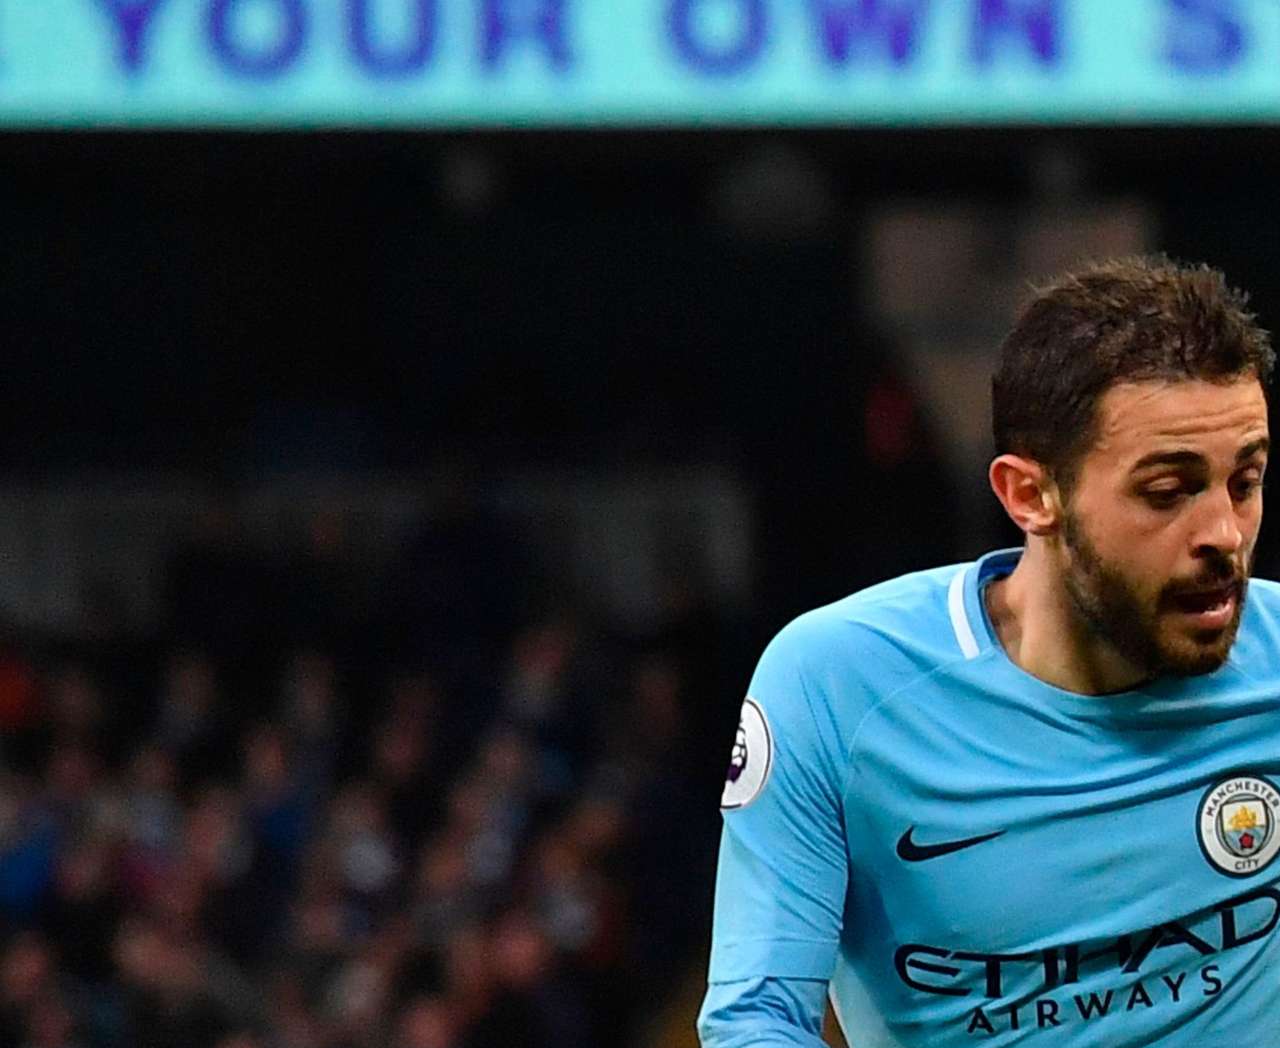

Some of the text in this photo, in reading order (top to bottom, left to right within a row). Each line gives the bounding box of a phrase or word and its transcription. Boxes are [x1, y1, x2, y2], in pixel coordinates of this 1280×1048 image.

[1206, 781, 1280, 818] MANCHESTER
[1235, 858, 1260, 871] CITY
[967, 964, 1223, 1034] AIRWAYS
